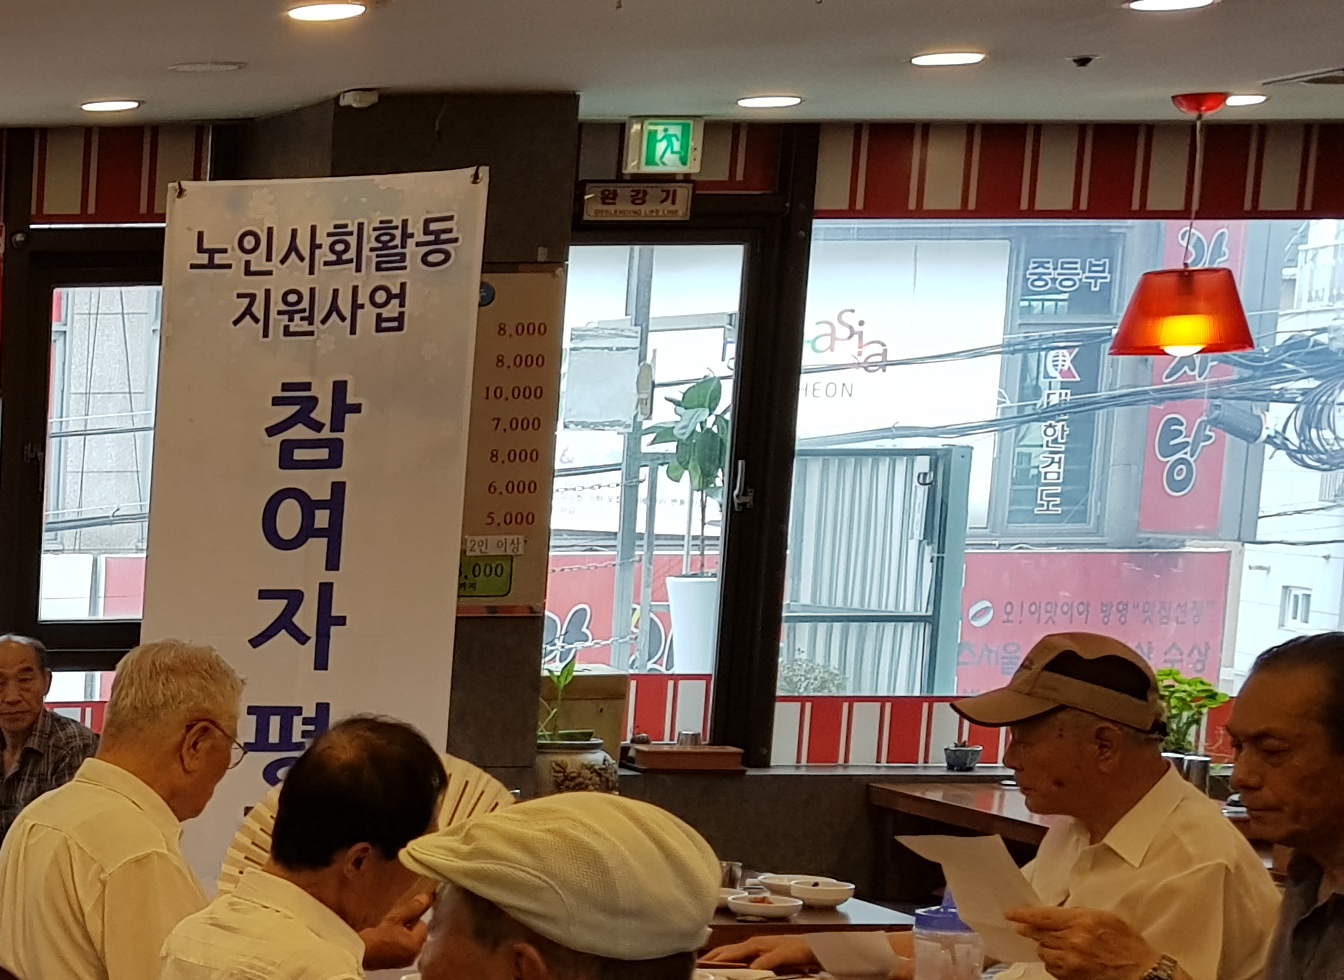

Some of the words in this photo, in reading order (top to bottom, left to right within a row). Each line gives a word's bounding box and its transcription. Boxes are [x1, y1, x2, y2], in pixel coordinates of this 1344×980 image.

[188, 213, 461, 277] 노인사회활동
[1025, 257, 1111, 292] 중등부
[231, 281, 410, 340] 지원사업
[497, 322, 547, 338] 8,000
[495, 354, 545, 370] 8,000
[484, 385, 544, 402] 10,000
[492, 416, 541, 433] 7,000
[489, 448, 539, 464] 8,000
[487, 480, 538, 496] 6,000
[247, 379, 363, 672] 참여자
[485, 511, 536, 527] 5,000
[459, 562, 505, 580] ,000
